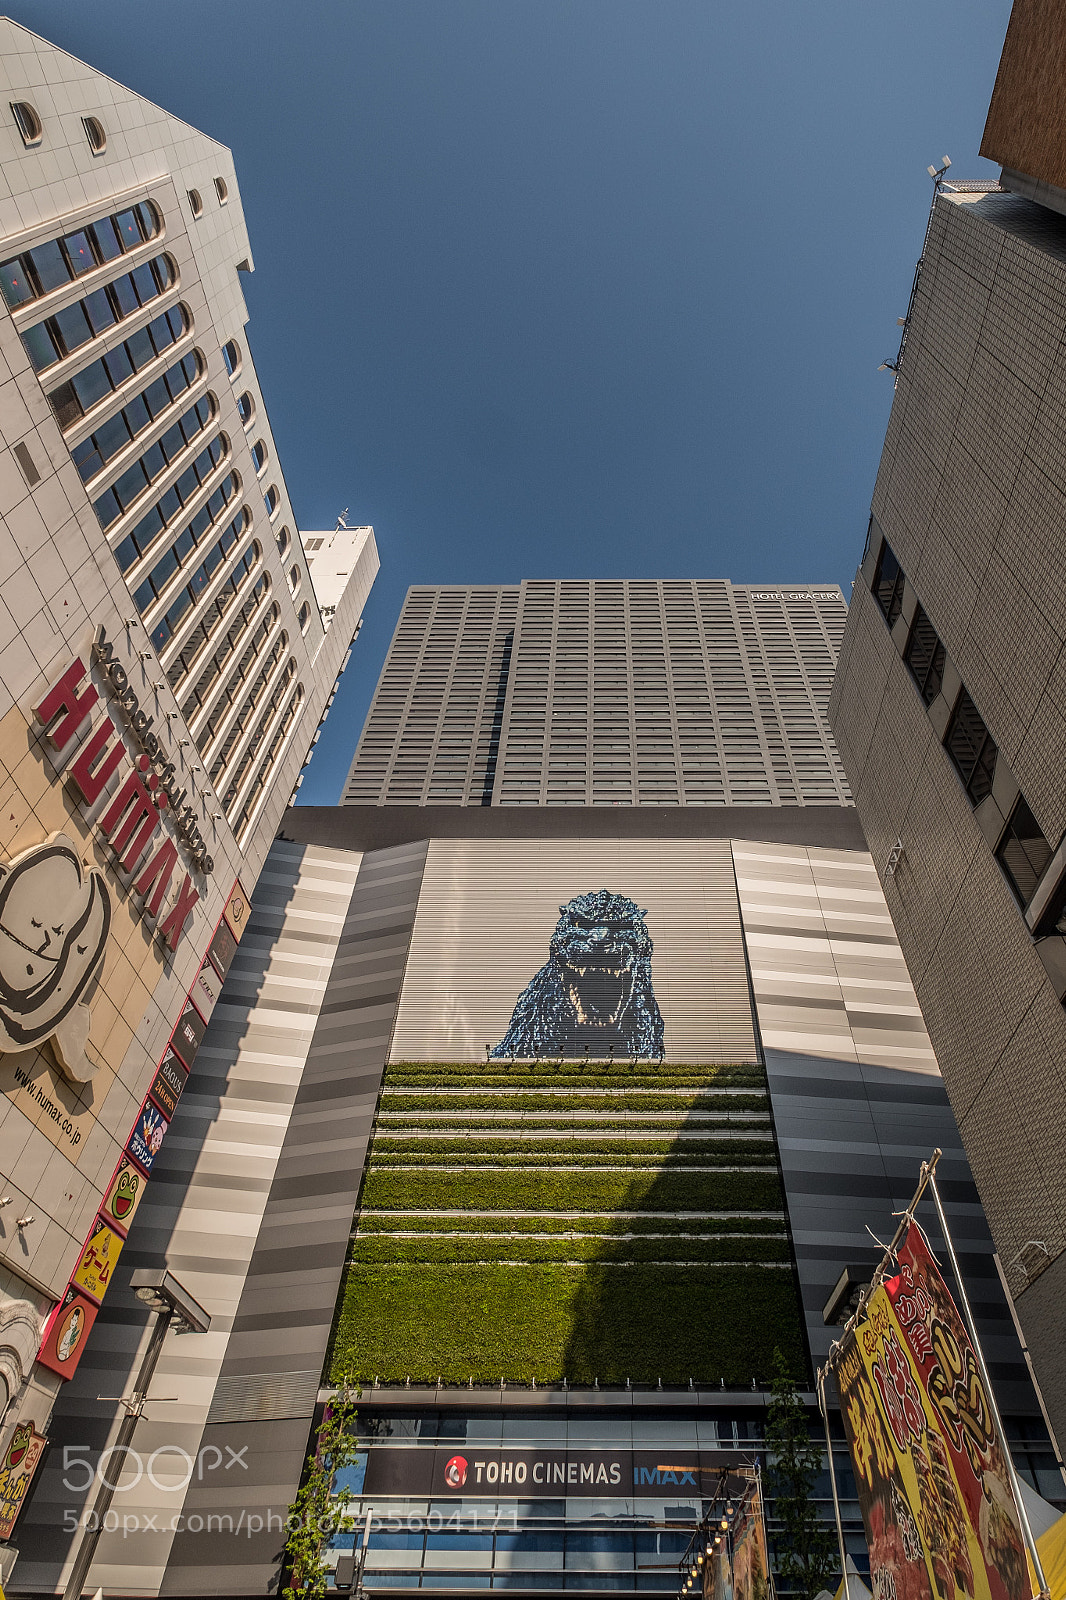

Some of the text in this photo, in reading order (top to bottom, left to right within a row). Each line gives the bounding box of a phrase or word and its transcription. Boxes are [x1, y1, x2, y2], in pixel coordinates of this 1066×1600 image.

[751, 592, 840, 601] HOTEL GRACERY
[91, 623, 188, 810] wonderful
[31, 655, 200, 954] HUMAX
[14, 1066, 82, 1146] www.humax.co.jp
[83, 1246, 110, 1285] ゲーム
[474, 1462, 698, 1486] TOHO CINEMAS IMAX
